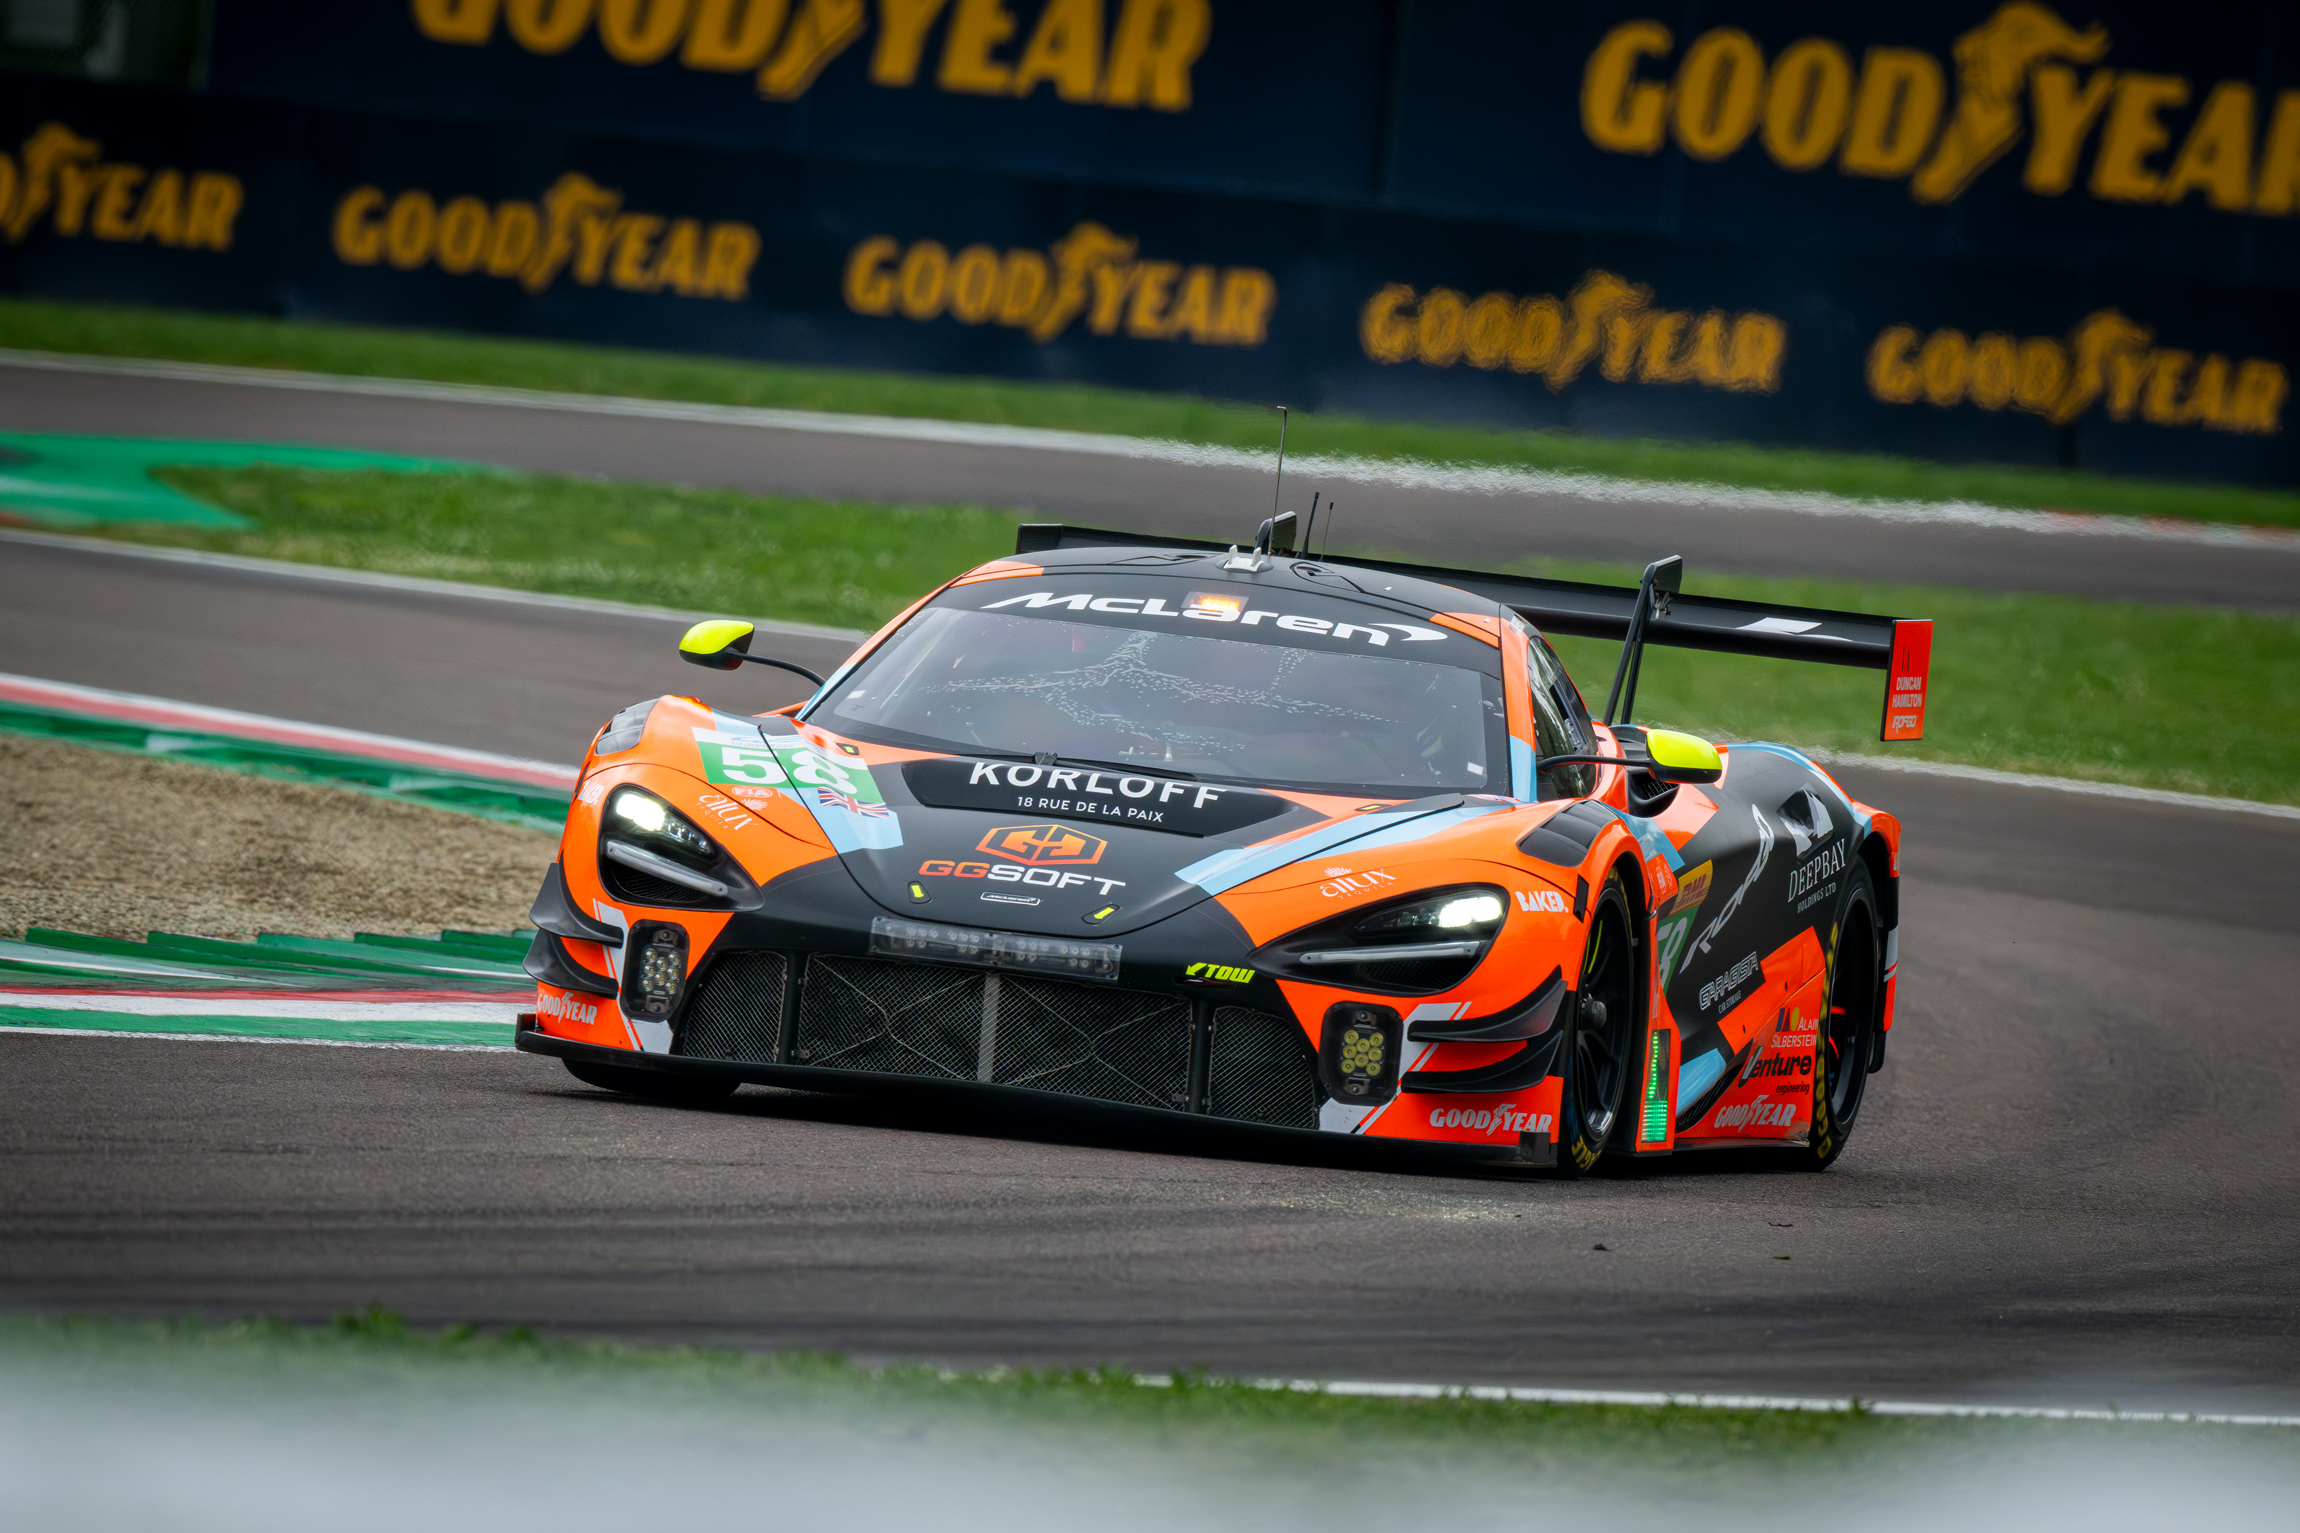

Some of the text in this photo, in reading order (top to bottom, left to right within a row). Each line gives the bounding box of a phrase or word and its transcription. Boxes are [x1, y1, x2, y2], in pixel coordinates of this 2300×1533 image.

[332, 171, 762, 300] GOODYEAR
[843, 222, 1276, 346] GOODYEAR
[1359, 268, 1789, 394] GOODYEAR
[1864, 307, 2289, 435] GOODYEAR
[981, 592, 1448, 647] McLaren
[1892, 693, 1922, 708] HAMILTON
[1896, 676, 1922, 690] DUNCAN
[721, 746, 858, 794] 58
[968, 761, 1228, 809] KORLOFF
[1017, 796, 1164, 823] 18 RUE DE LA PAIX
[918, 859, 1127, 896] GGSOFT
[1787, 838, 1846, 903] DEEPBAY
[1338, 881, 1394, 900] TEQUILA
[1797, 881, 1837, 914] HOLDINGS LTD
[1204, 963, 1256, 984] TOW
[537, 991, 598, 1025] GOODYEAR
[1770, 1034, 1818, 1049] SILBERSTEIN
[1738, 1045, 1812, 1089] Venture
[1775, 1081, 1810, 1096] engineering
[1429, 1103, 1553, 1136] GOODYEAR
[1714, 1094, 1796, 1132] GOODYEAR
